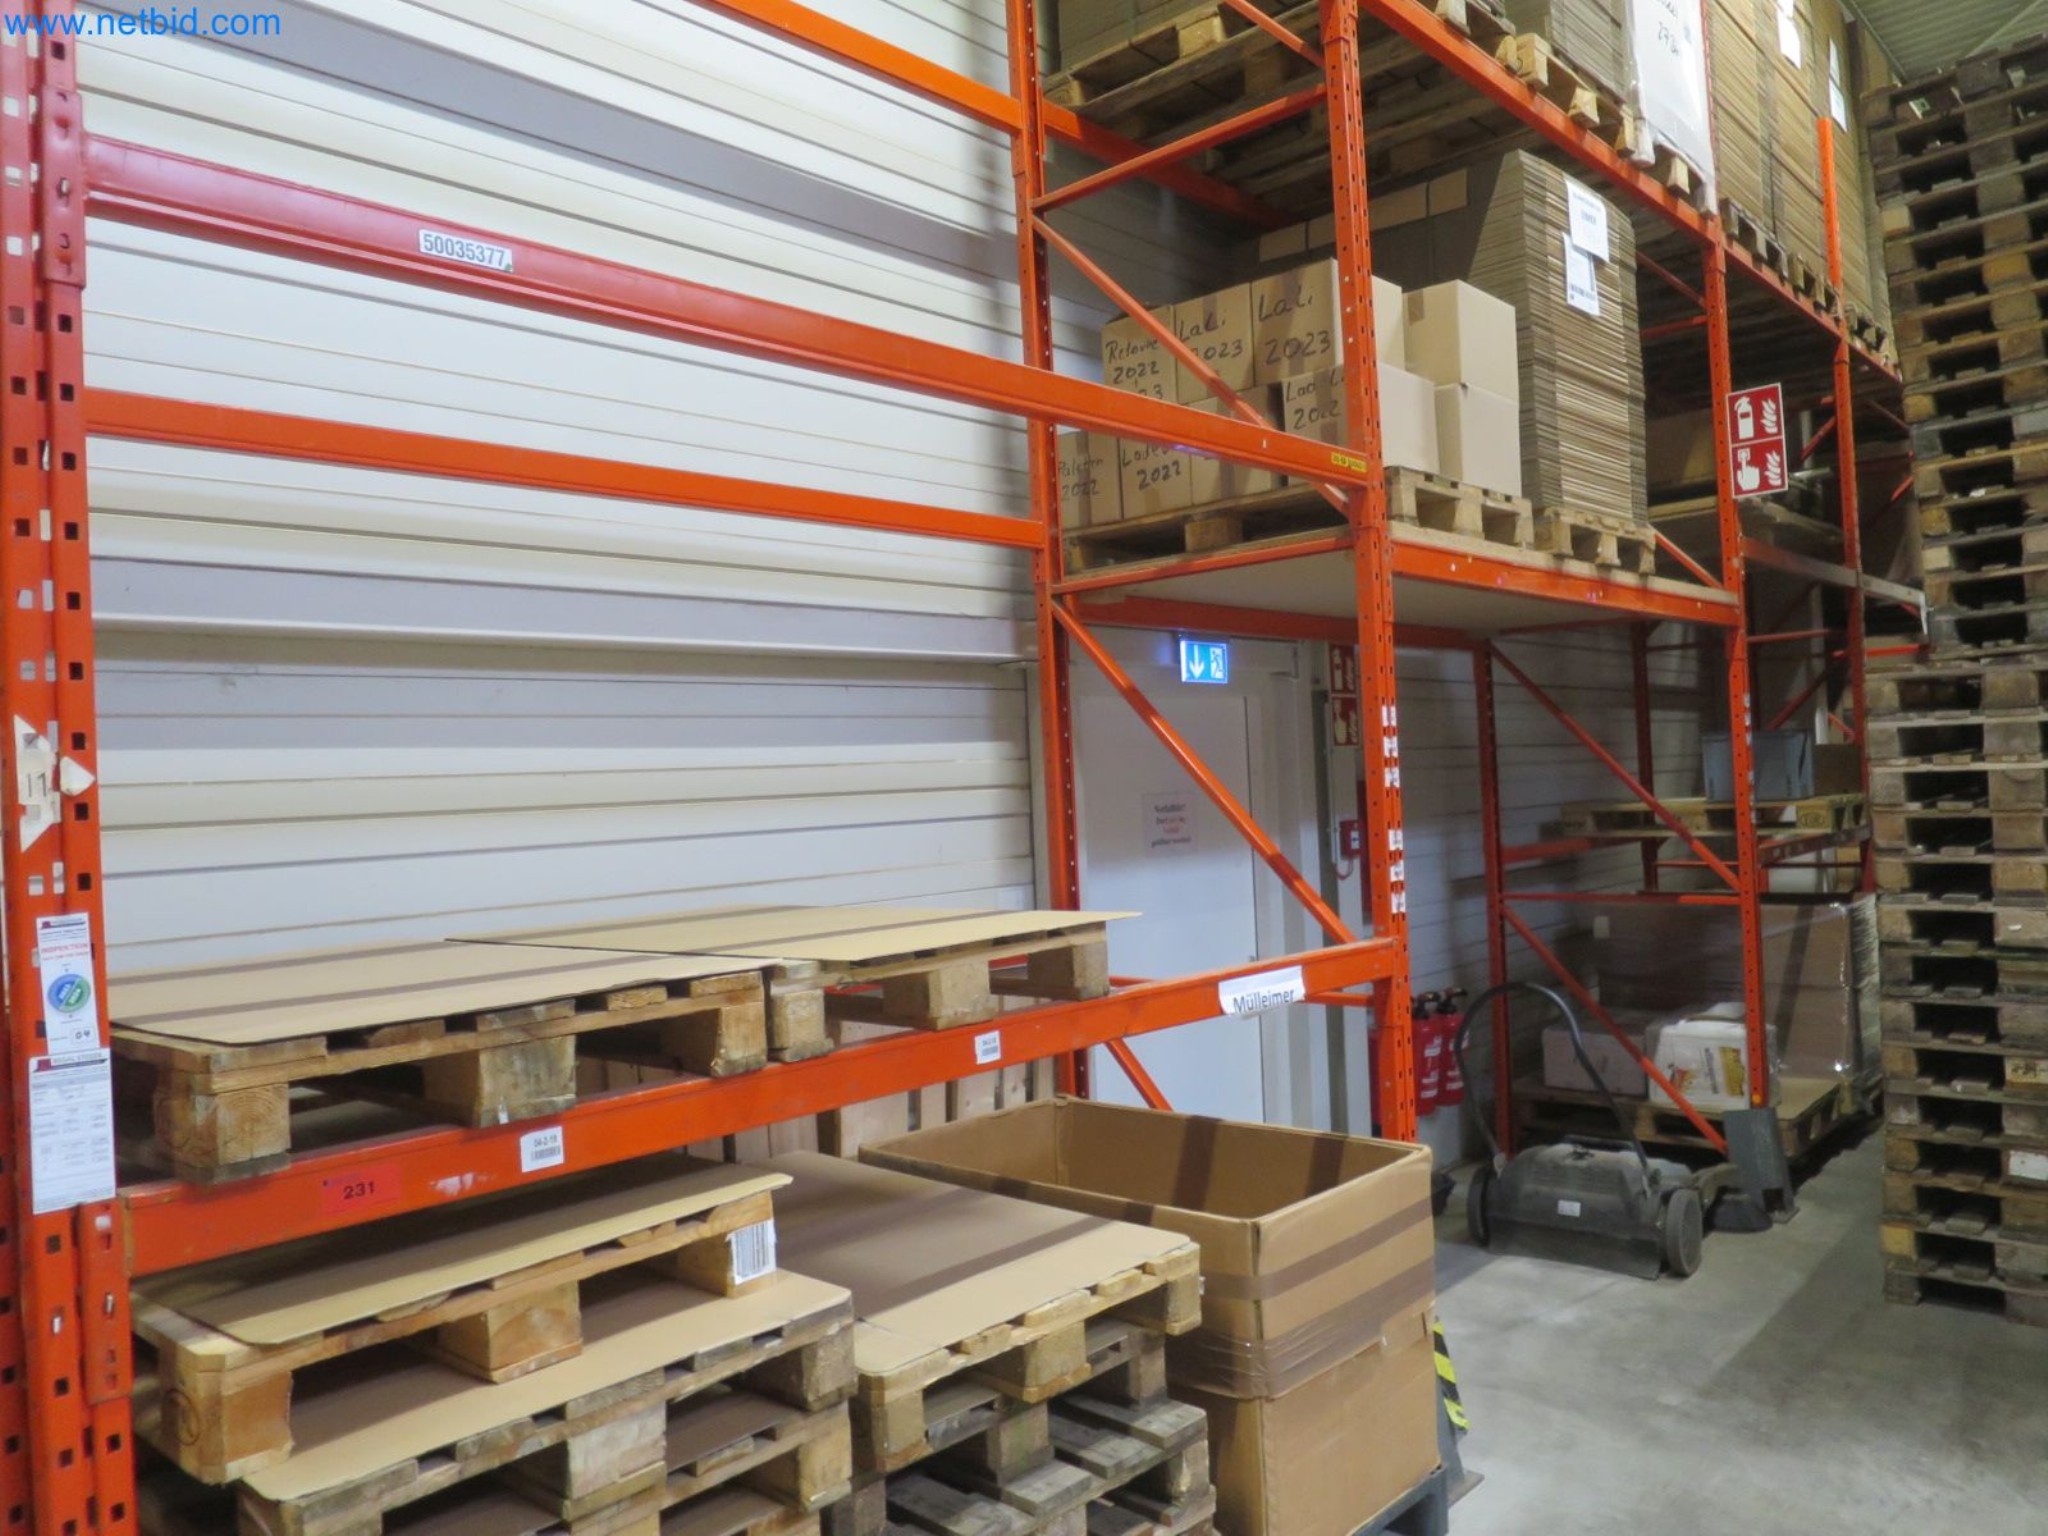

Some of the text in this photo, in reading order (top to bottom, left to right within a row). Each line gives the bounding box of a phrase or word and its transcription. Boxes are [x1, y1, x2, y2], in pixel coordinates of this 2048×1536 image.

[422, 232, 506, 267] 50035377
[1264, 329, 1332, 365] 2023
[1112, 360, 1161, 385] 2022
[1136, 459, 1182, 491] 2022
[1233, 989, 1294, 1013] Mülleimer
[343, 1181, 374, 1200] 231
